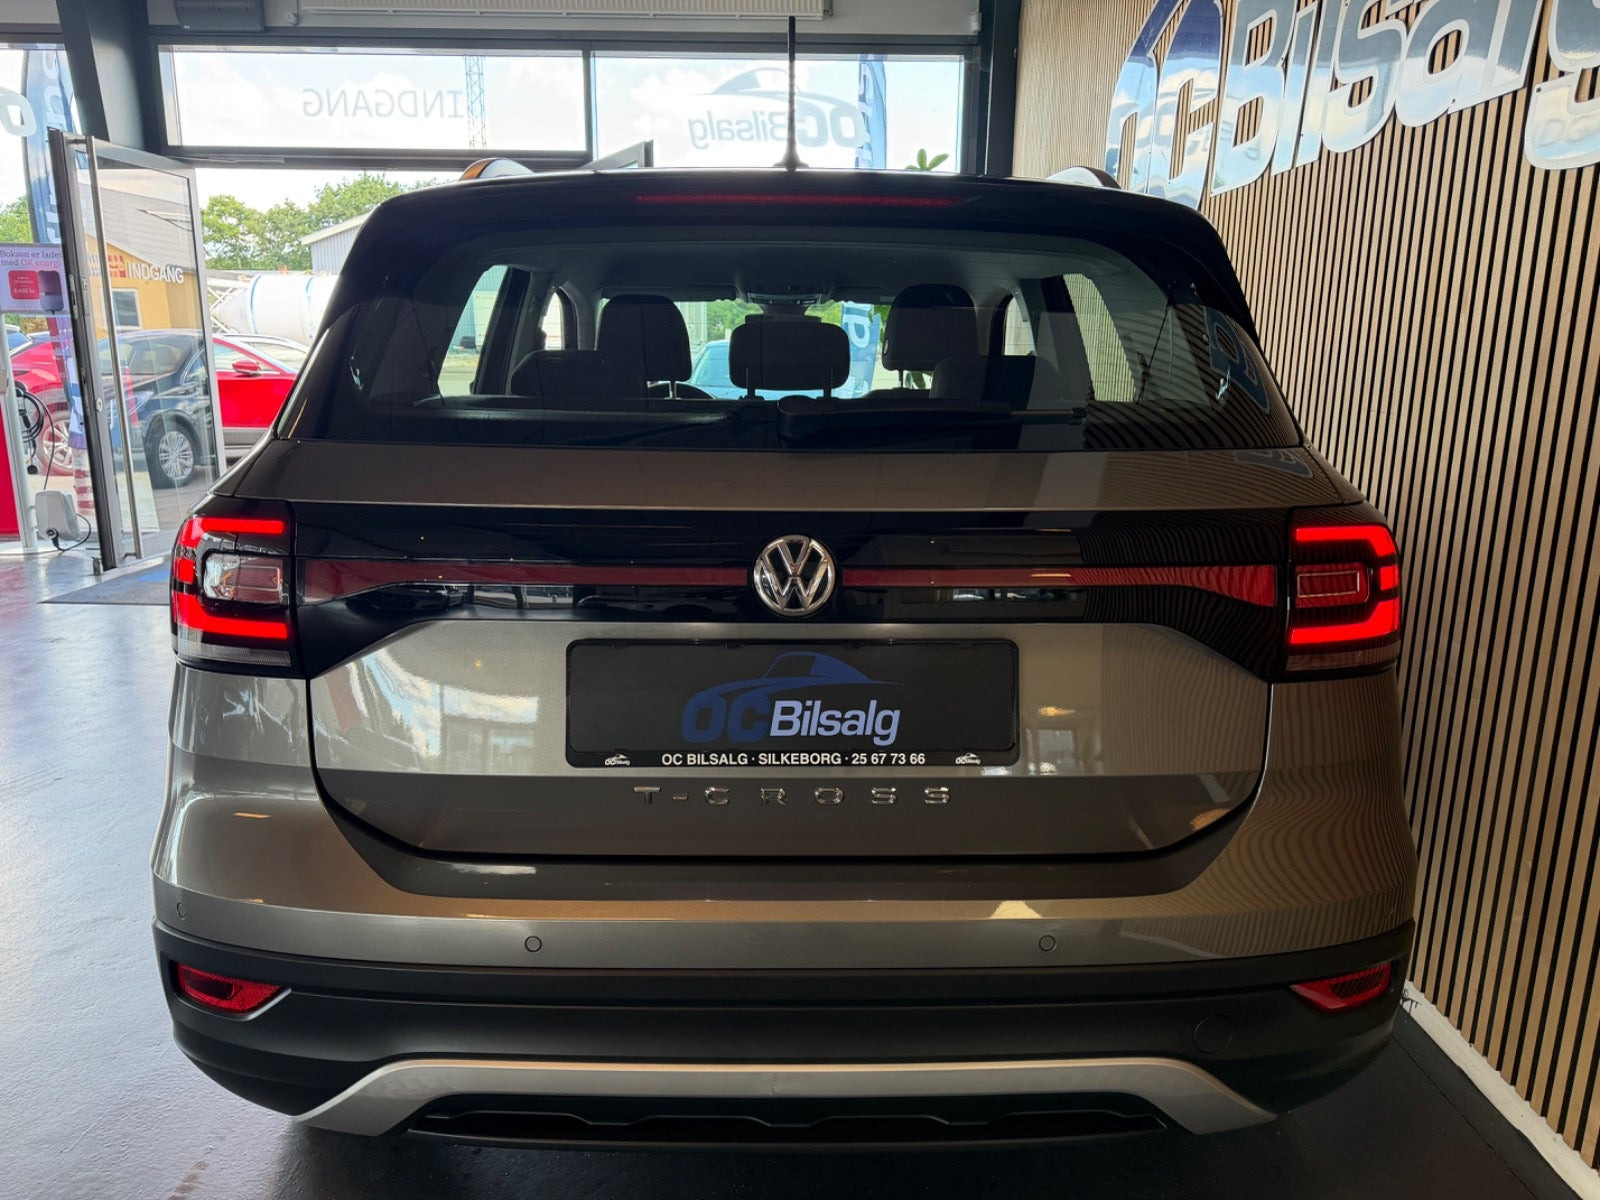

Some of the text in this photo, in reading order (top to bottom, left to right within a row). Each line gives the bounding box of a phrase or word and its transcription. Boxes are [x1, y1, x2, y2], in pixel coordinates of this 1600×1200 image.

[127, 261, 184, 284] INDGANG
[661, 753, 926, 766] OC BILSALG SILKEBORG 25 67 73 66
[633, 786, 951, 806] T-CROSS
